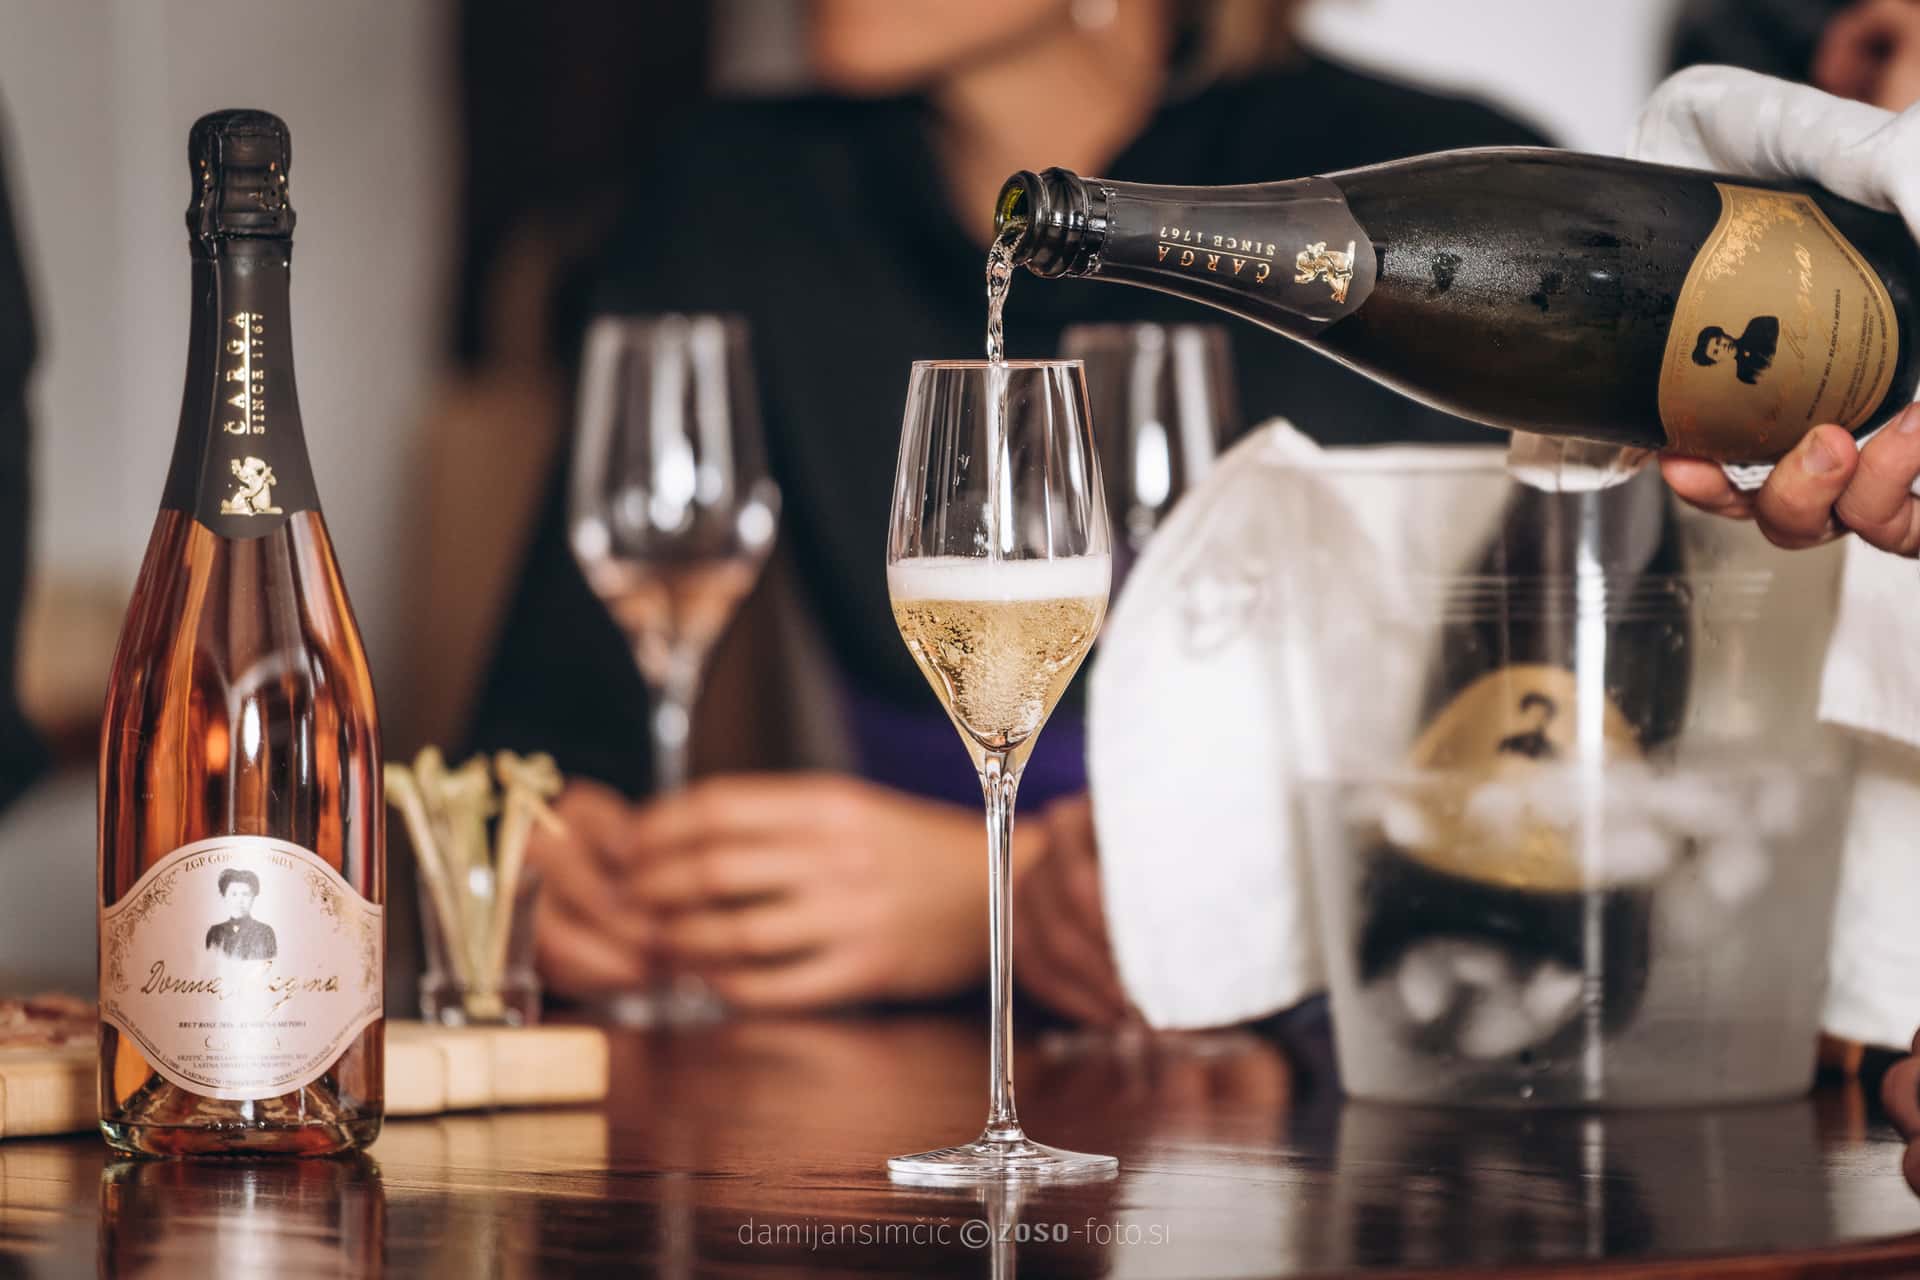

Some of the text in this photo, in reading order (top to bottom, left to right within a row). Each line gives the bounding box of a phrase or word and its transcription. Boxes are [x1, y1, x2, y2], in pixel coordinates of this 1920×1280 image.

[1159, 226, 1277, 256] SINCE 1767
[1157, 245, 1272, 284] ČARGA
[223, 311, 246, 435] ČARGA
[251, 312, 265, 435] SINCE 1767
[140, 960, 224, 995] Donna
